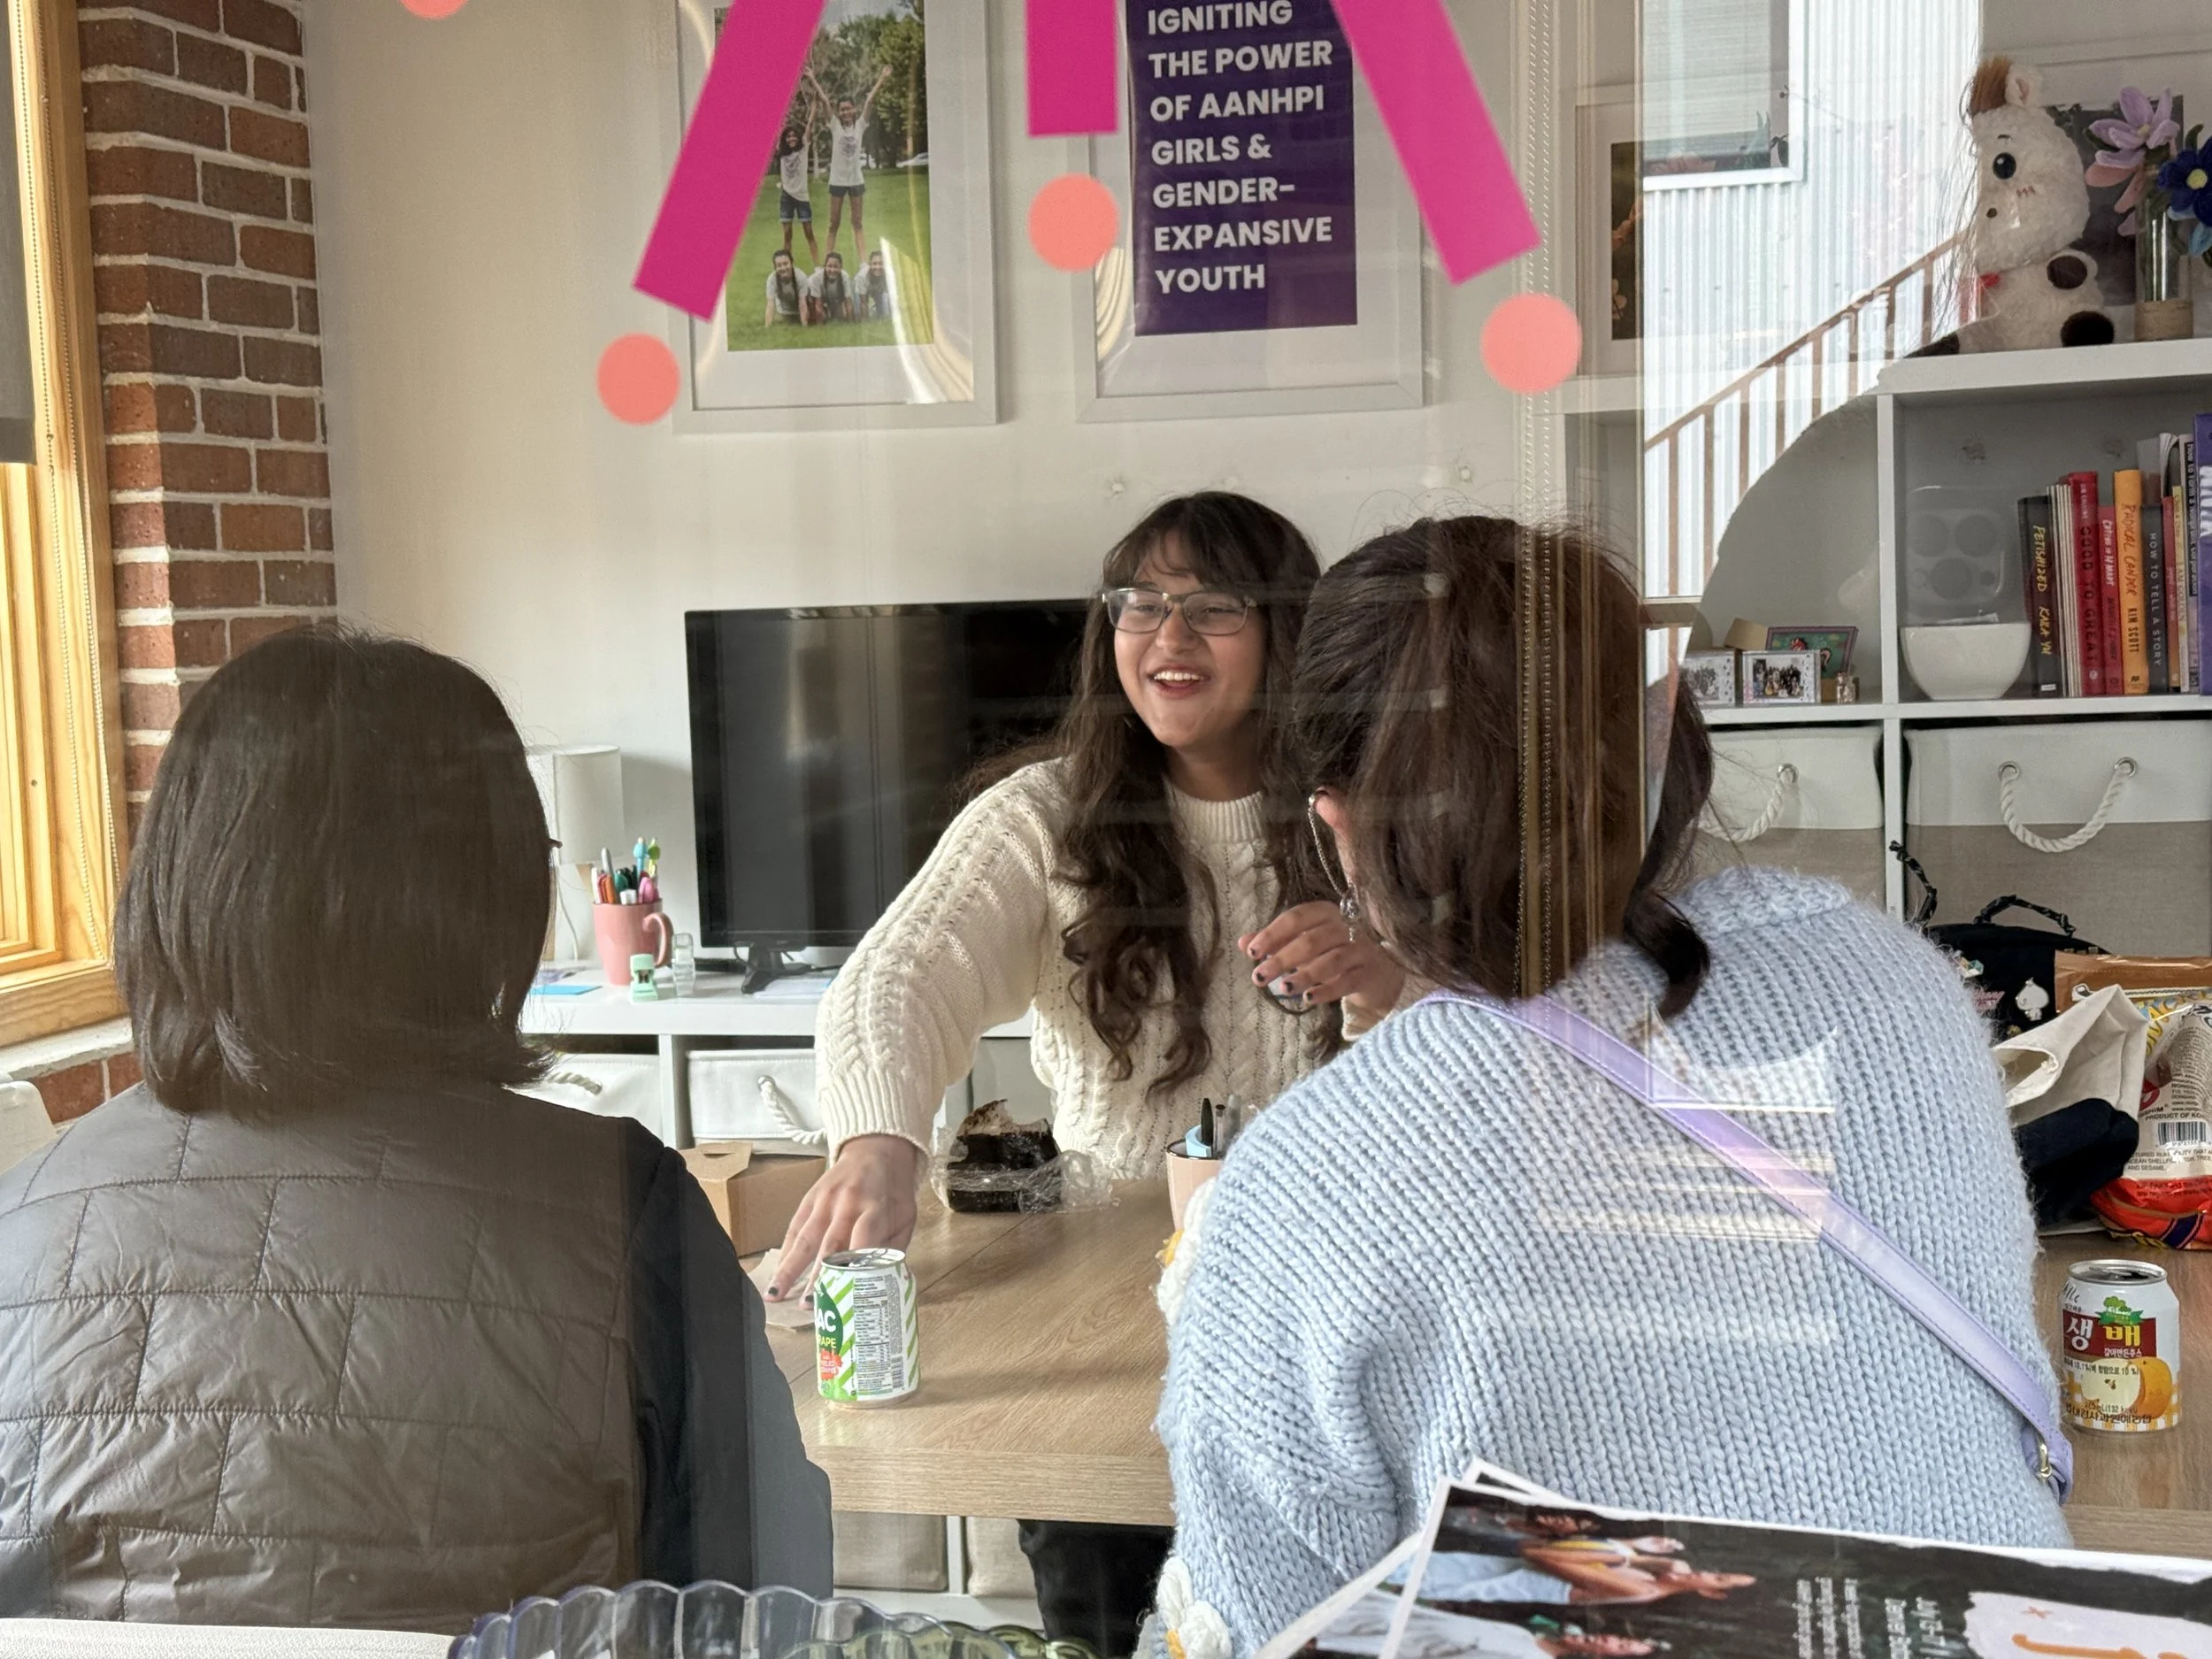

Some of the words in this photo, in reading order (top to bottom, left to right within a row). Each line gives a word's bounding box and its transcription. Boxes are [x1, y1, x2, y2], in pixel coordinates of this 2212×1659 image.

[1148, 0, 1293, 35] IGNITING
[1148, 50, 1208, 79] THE
[1215, 41, 1333, 74] POWER
[1150, 95, 1191, 122] OF
[1199, 85, 1324, 119] AANHPI
[1151, 135, 1240, 165] GIRLS
[1248, 134, 1272, 159] &
[1153, 177, 1295, 209] GENDER-
[1155, 217, 1333, 251] EXPANSIVE
[1156, 264, 1265, 294] YOUTH
[2121, 504, 2138, 551] RADICAL
[2032, 525, 2047, 593] FETISHIZED
[2079, 526, 2093, 572] GOOD
[2148, 533, 2158, 560] HOW
[2124, 555, 2138, 596] CANDOR
[2150, 565, 2159, 579] TO
[2082, 581, 2095, 600] TO
[2151, 585, 2160, 612] TELL
[2127, 607, 2138, 624] KIM
[2083, 609, 2097, 662] GREAT
[2128, 626, 2139, 654] SCOTT
[2153, 629, 2162, 666] STORY
[815, 1310, 836, 1333] AC
[2065, 1317, 2094, 1351] 생
[2102, 1325, 2141, 1348] 배
